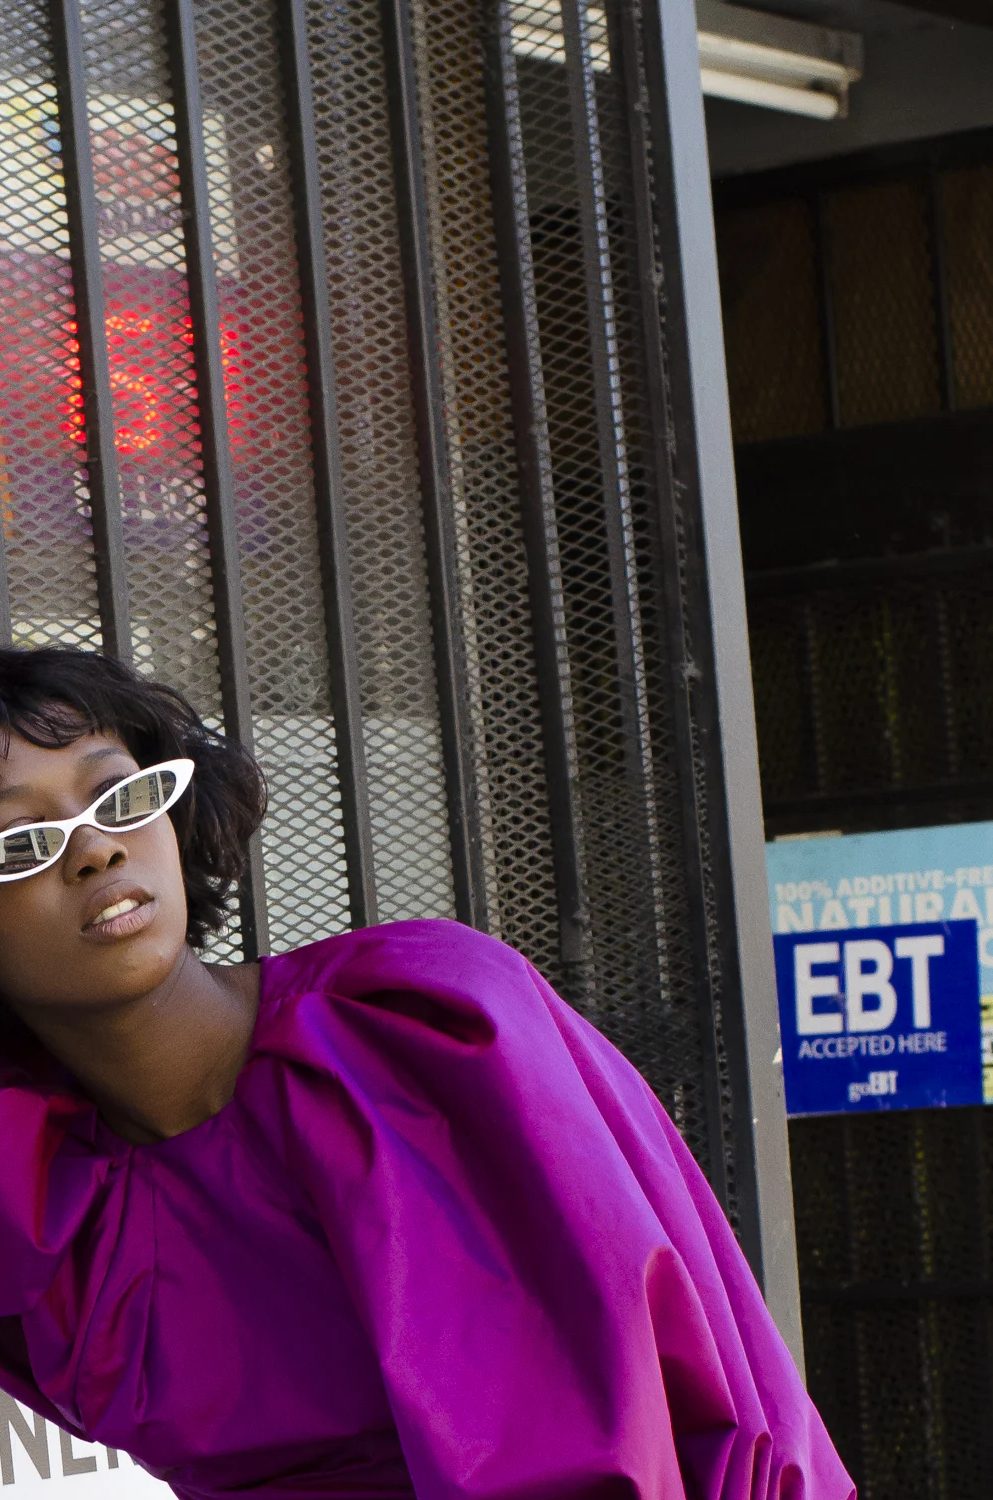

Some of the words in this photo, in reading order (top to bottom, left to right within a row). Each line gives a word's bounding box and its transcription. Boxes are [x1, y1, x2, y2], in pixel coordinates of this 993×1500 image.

[794, 935, 945, 1036] EBT
[798, 1035, 895, 1059] ACCEPTED
[898, 1031, 947, 1054] HERE
